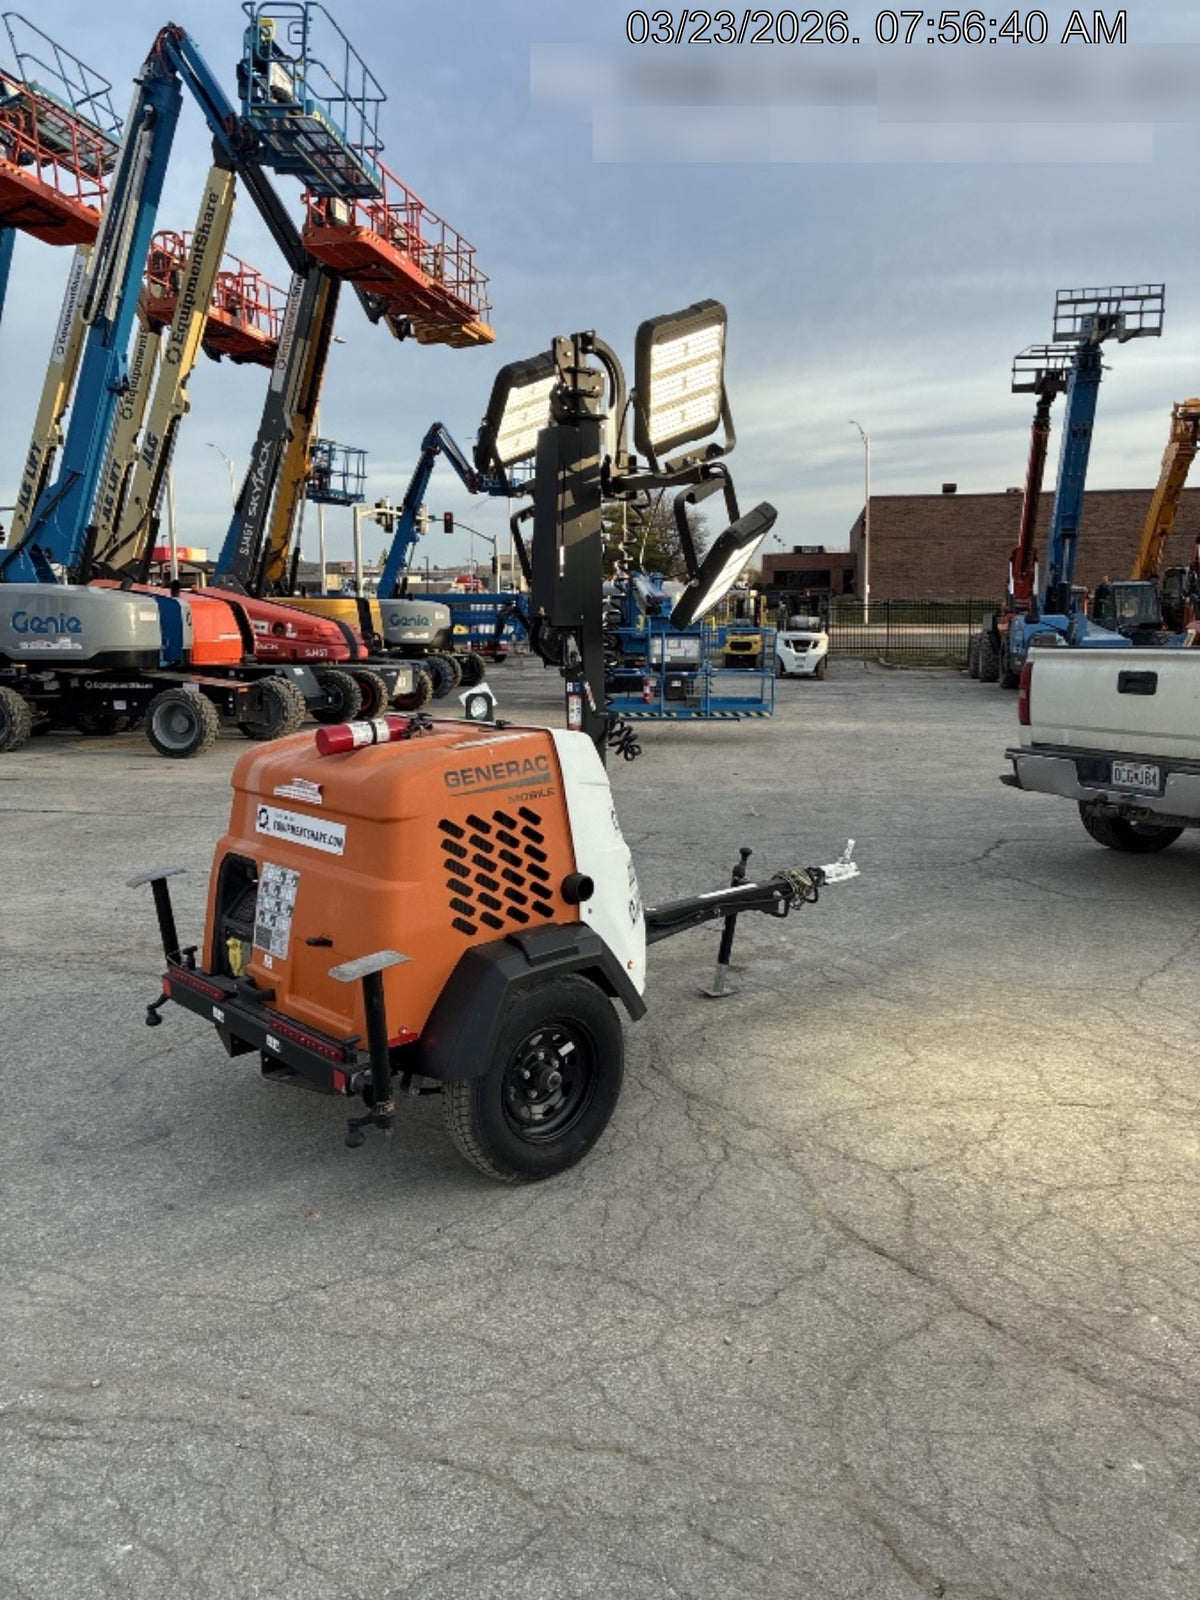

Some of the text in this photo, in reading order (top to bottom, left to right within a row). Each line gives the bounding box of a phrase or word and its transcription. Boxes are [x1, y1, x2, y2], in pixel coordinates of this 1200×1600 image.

[172, 193, 219, 344] EquipmentShare
[142, 432, 159, 471] JLG
[18, 441, 41, 513] JLG LIFT
[103, 458, 121, 522] JLG LIFT
[248, 441, 272, 517] SKYJACK
[12, 611, 82, 633] Genie
[390, 613, 430, 627] Genie
[444, 755, 550, 788] GENERAC
[508, 787, 555, 804] MOBILE
